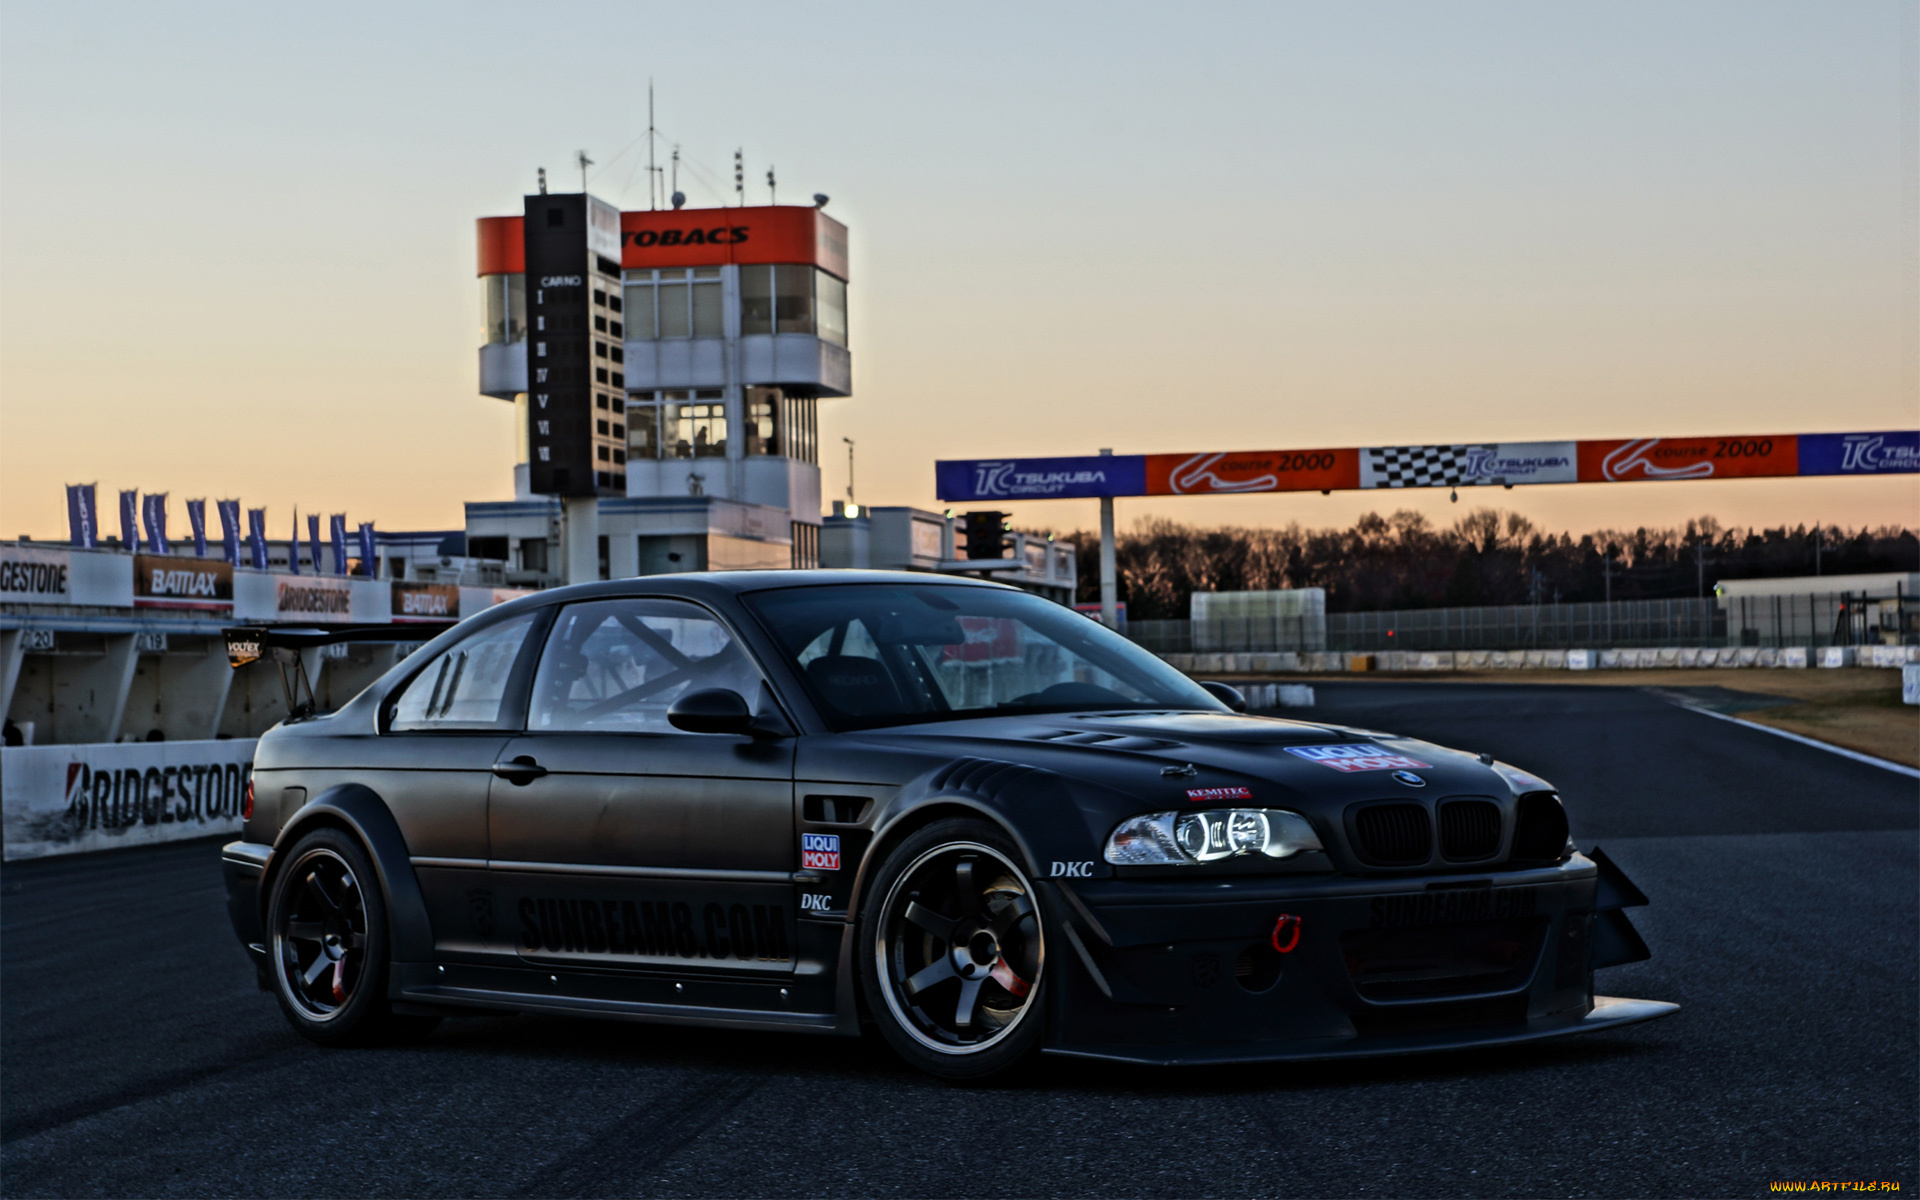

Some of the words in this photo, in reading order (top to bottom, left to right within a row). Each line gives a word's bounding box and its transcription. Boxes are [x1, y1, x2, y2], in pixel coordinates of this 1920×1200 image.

[537, 394, 549, 409] V
[1654, 446, 1708, 458] course
[1714, 439, 1773, 458] 2000
[1220, 460, 1273, 472] course
[1277, 453, 1336, 472] 2000
[1498, 457, 1569, 468] TSUKUBA
[1014, 470, 1106, 485] TSUKUBA
[1009, 483, 1066, 494] CIRCUIT
[278, 582, 350, 614] BRIDGESTONE
[34, 632, 50, 648] 20
[228, 642, 260, 651] VOLTEX
[1292, 745, 1396, 760] LIQUI
[1322, 756, 1420, 771] MOLY
[1186, 787, 1249, 797] KEMITEC
[803, 835, 838, 851] LIQUI
[803, 852, 840, 868] MOLY
[1050, 860, 1095, 877] DKC
[801, 893, 833, 911] DKC
[518, 897, 790, 962] SUNBEAM8.COM
